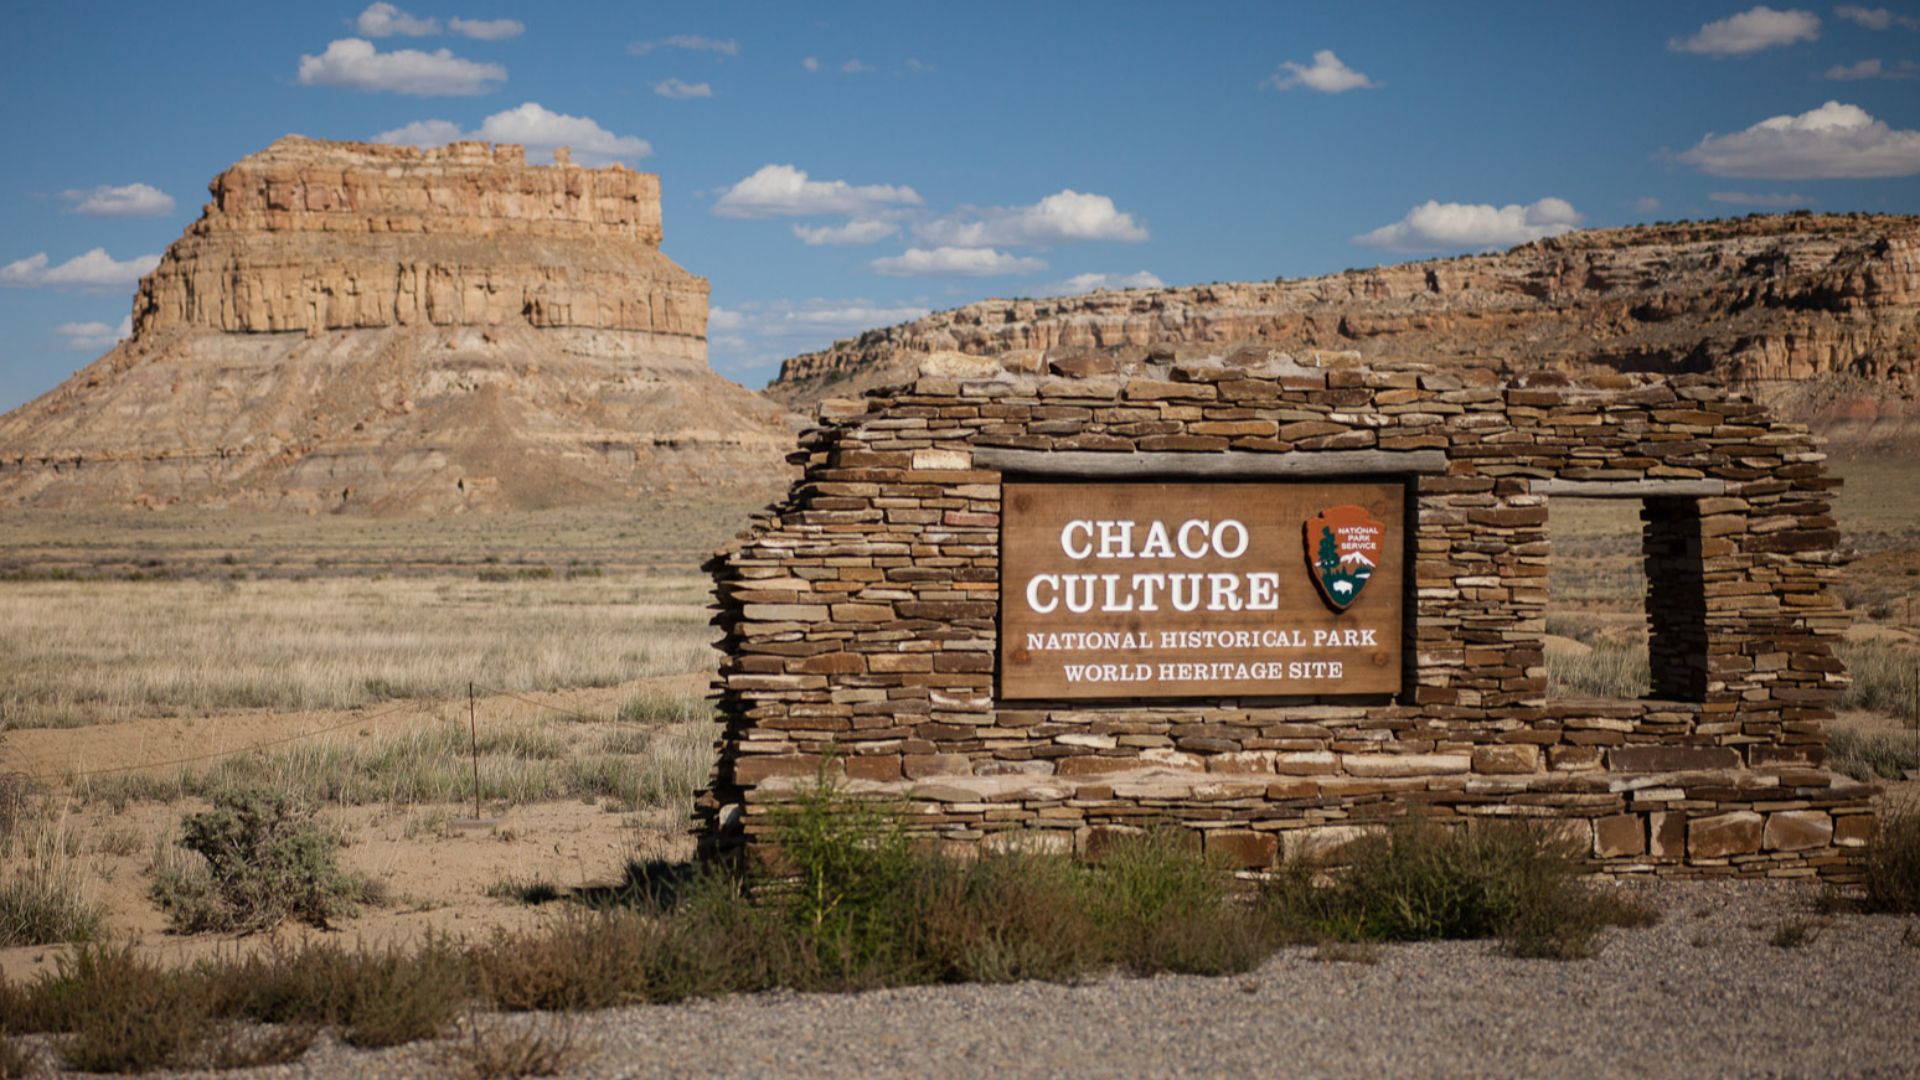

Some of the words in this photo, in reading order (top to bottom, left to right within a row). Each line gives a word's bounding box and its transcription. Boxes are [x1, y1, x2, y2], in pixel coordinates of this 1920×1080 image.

[1060, 519, 1249, 559] CHACO
[1341, 542, 1376, 550] SERVICE
[1026, 572, 1279, 613] CULTURE
[1026, 631, 1153, 650] NATIONAL
[1160, 630, 1306, 649] HISTORICAL
[1313, 629, 1378, 647] PARK
[1064, 663, 1153, 682] WORLD
[1158, 662, 1282, 681] HERITAGE
[1289, 662, 1343, 680] SITE
